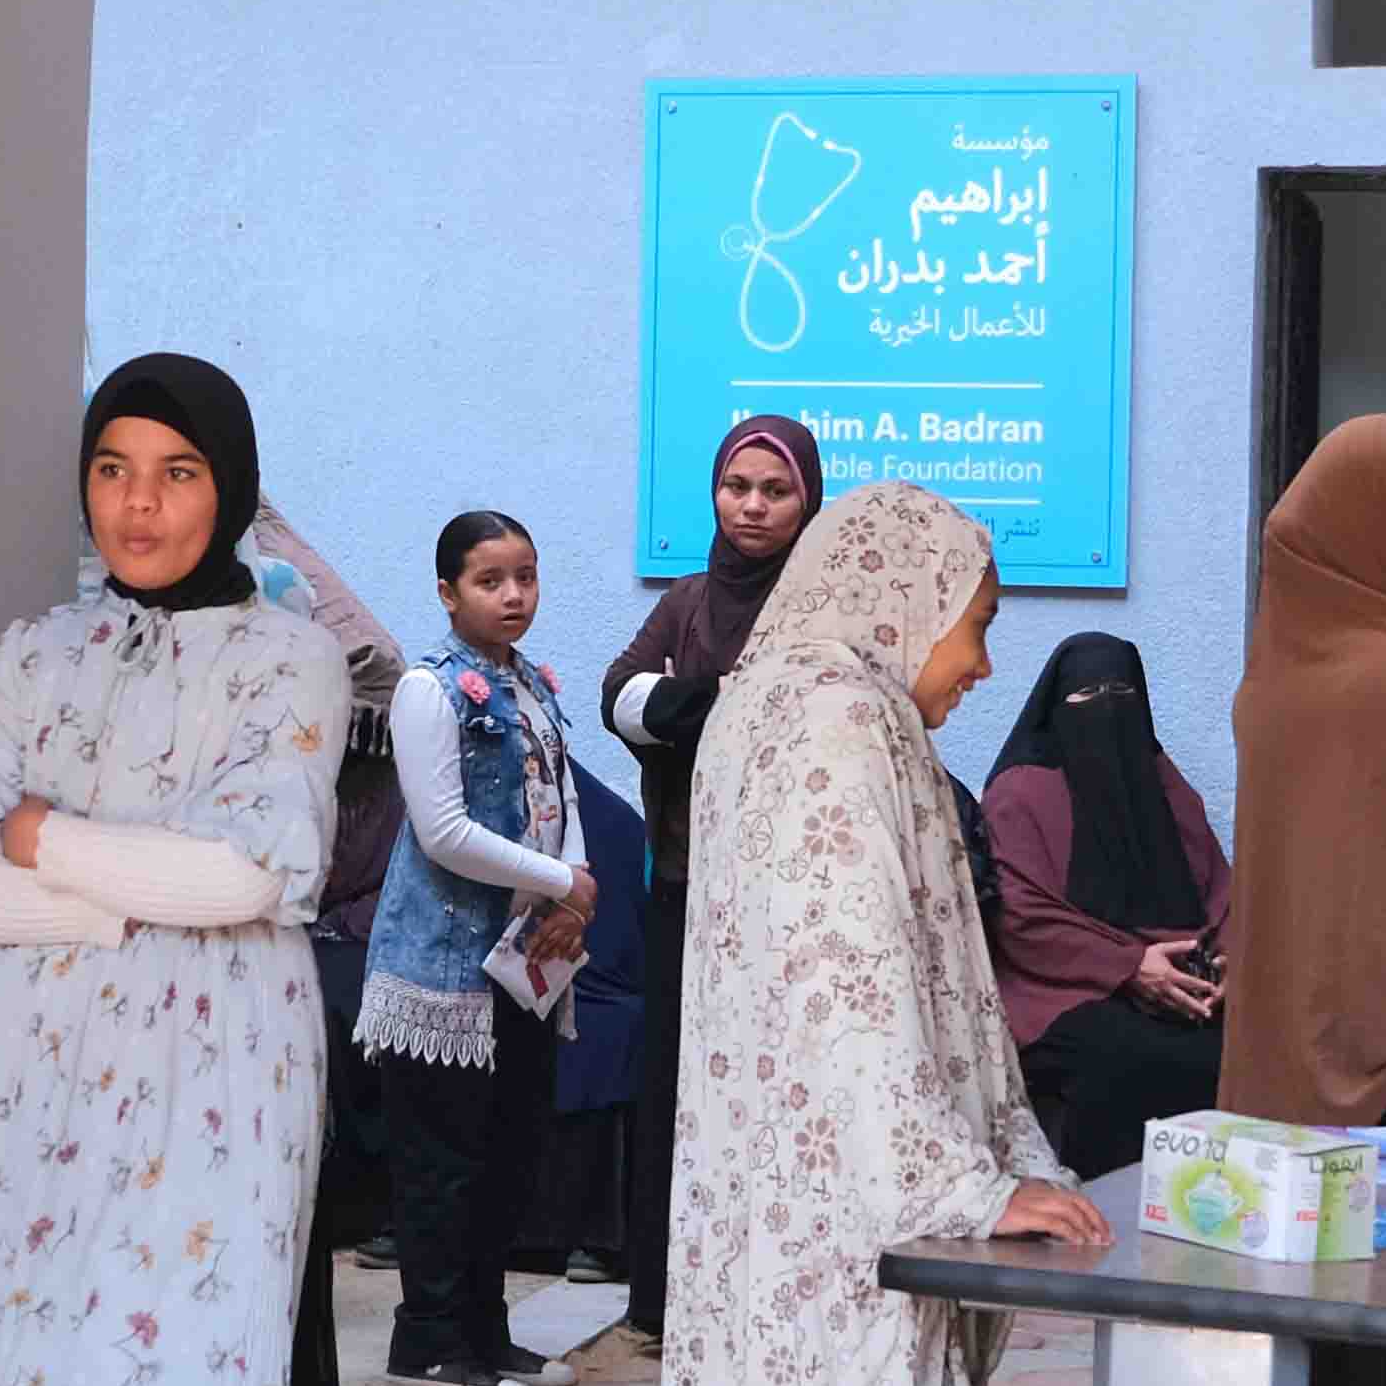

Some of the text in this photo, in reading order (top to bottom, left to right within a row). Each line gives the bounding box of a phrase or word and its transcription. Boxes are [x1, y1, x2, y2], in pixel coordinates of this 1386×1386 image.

[952, 123, 1050, 159] مؤسسة
[910, 166, 1048, 241] ابراهيم
[838, 221, 1049, 295] أحمد بدران
[869, 301, 1046, 348] للأعمال الخيرية
[872, 413, 909, 443] A.
[920, 413, 1043, 443] Badran
[883, 455, 1042, 484] Foundation
